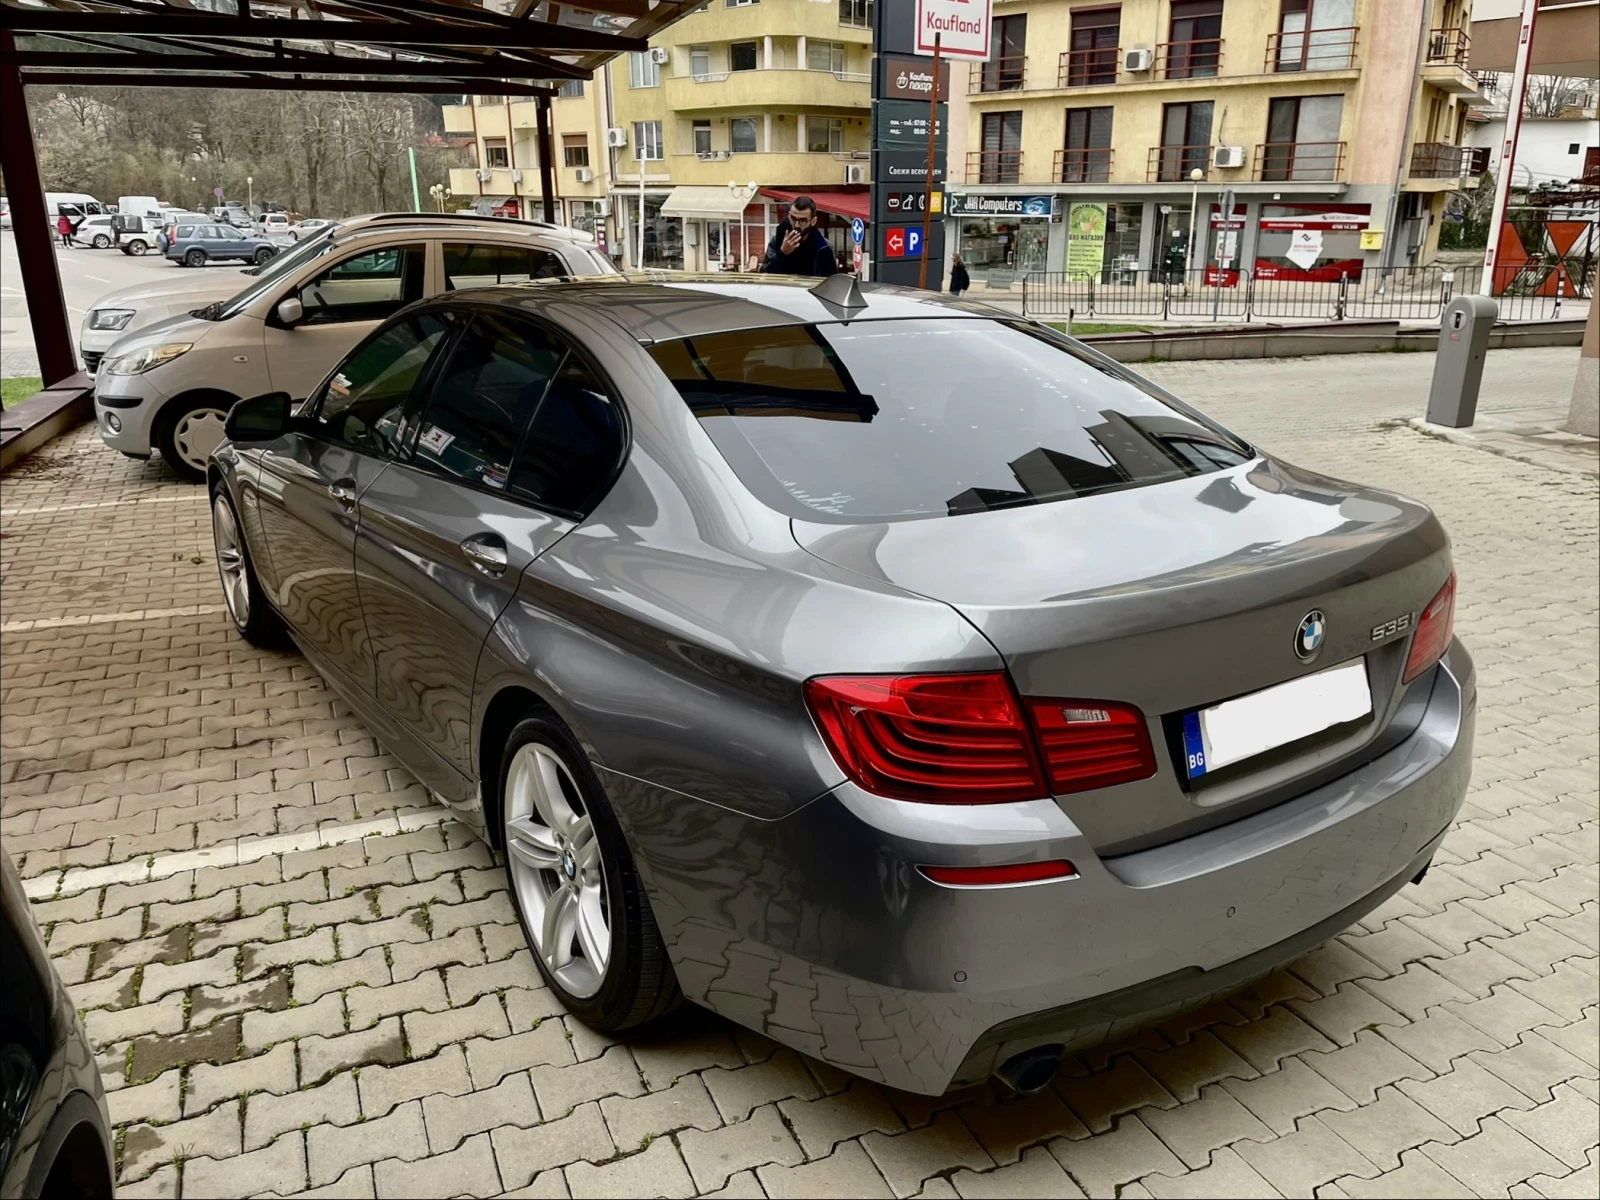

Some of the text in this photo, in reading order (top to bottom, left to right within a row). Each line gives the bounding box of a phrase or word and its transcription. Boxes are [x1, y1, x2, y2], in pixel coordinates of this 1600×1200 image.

[927, 11, 981, 34] Kaufland
[889, 166, 910, 175] Свежи
[964, 196, 978, 210] JAR
[979, 196, 1022, 214] Computers
[909, 232, 919, 251] P
[1189, 752, 1204, 769] BG
